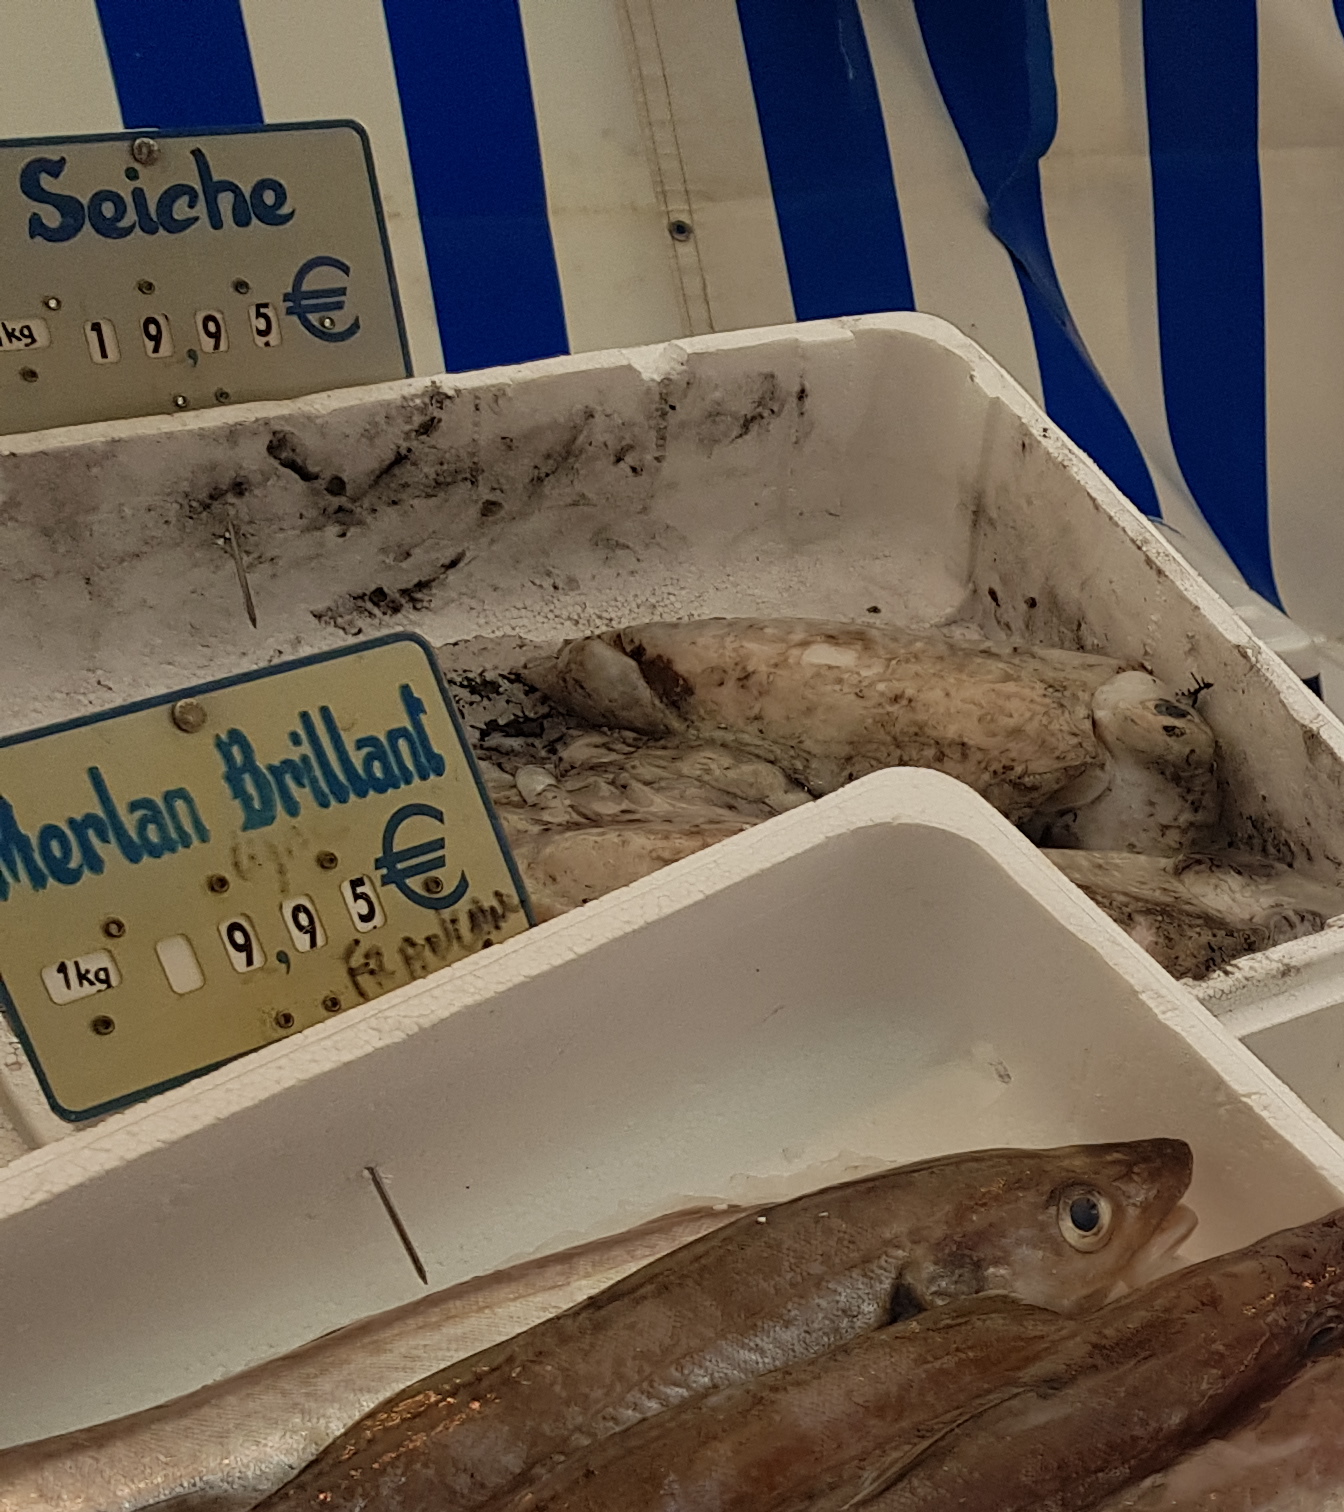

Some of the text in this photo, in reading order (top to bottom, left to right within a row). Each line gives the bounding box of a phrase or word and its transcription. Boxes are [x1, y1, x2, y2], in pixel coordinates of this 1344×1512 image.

[20, 147, 295, 243] Seiche
[0, 321, 37, 347] kg
[282, 256, 361, 343] €
[0, 683, 446, 902] Merlan Brillant
[56, 959, 115, 993] 1kg
[375, 803, 469, 910] €
